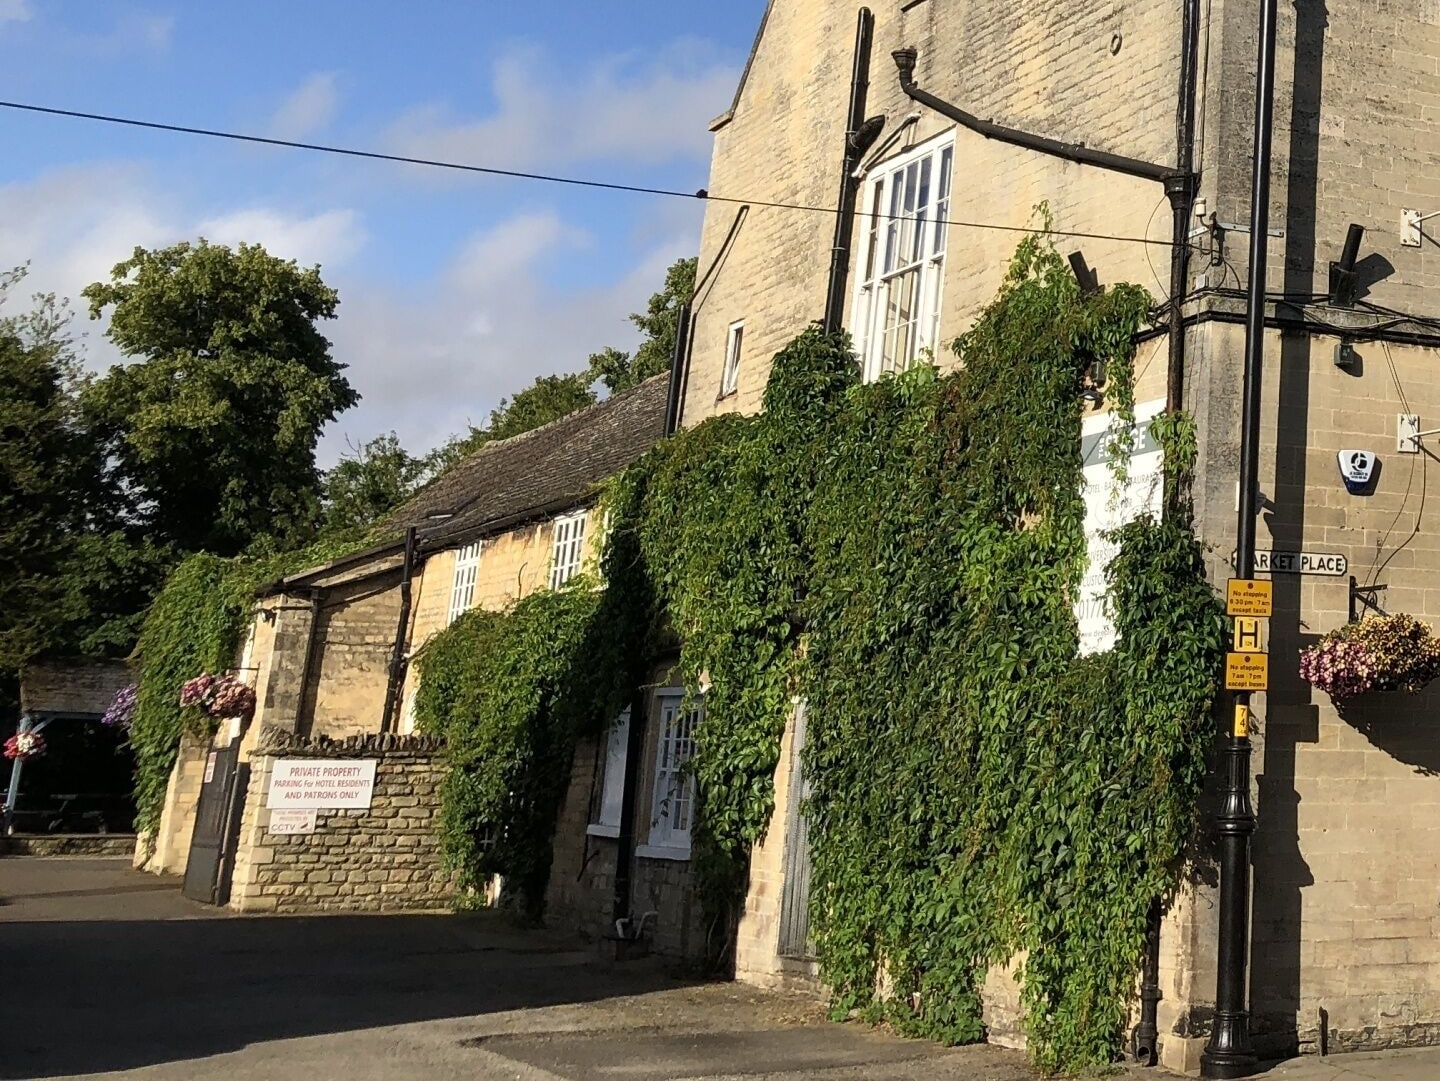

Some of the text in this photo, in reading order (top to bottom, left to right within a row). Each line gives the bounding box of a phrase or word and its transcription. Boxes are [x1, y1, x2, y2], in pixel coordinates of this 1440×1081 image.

[1301, 556, 1343, 571] PLACE
[1239, 620, 1258, 648] H
[290, 767, 361, 777] PRIVATE PROPERTY
[271, 823, 295, 832] CCTV
